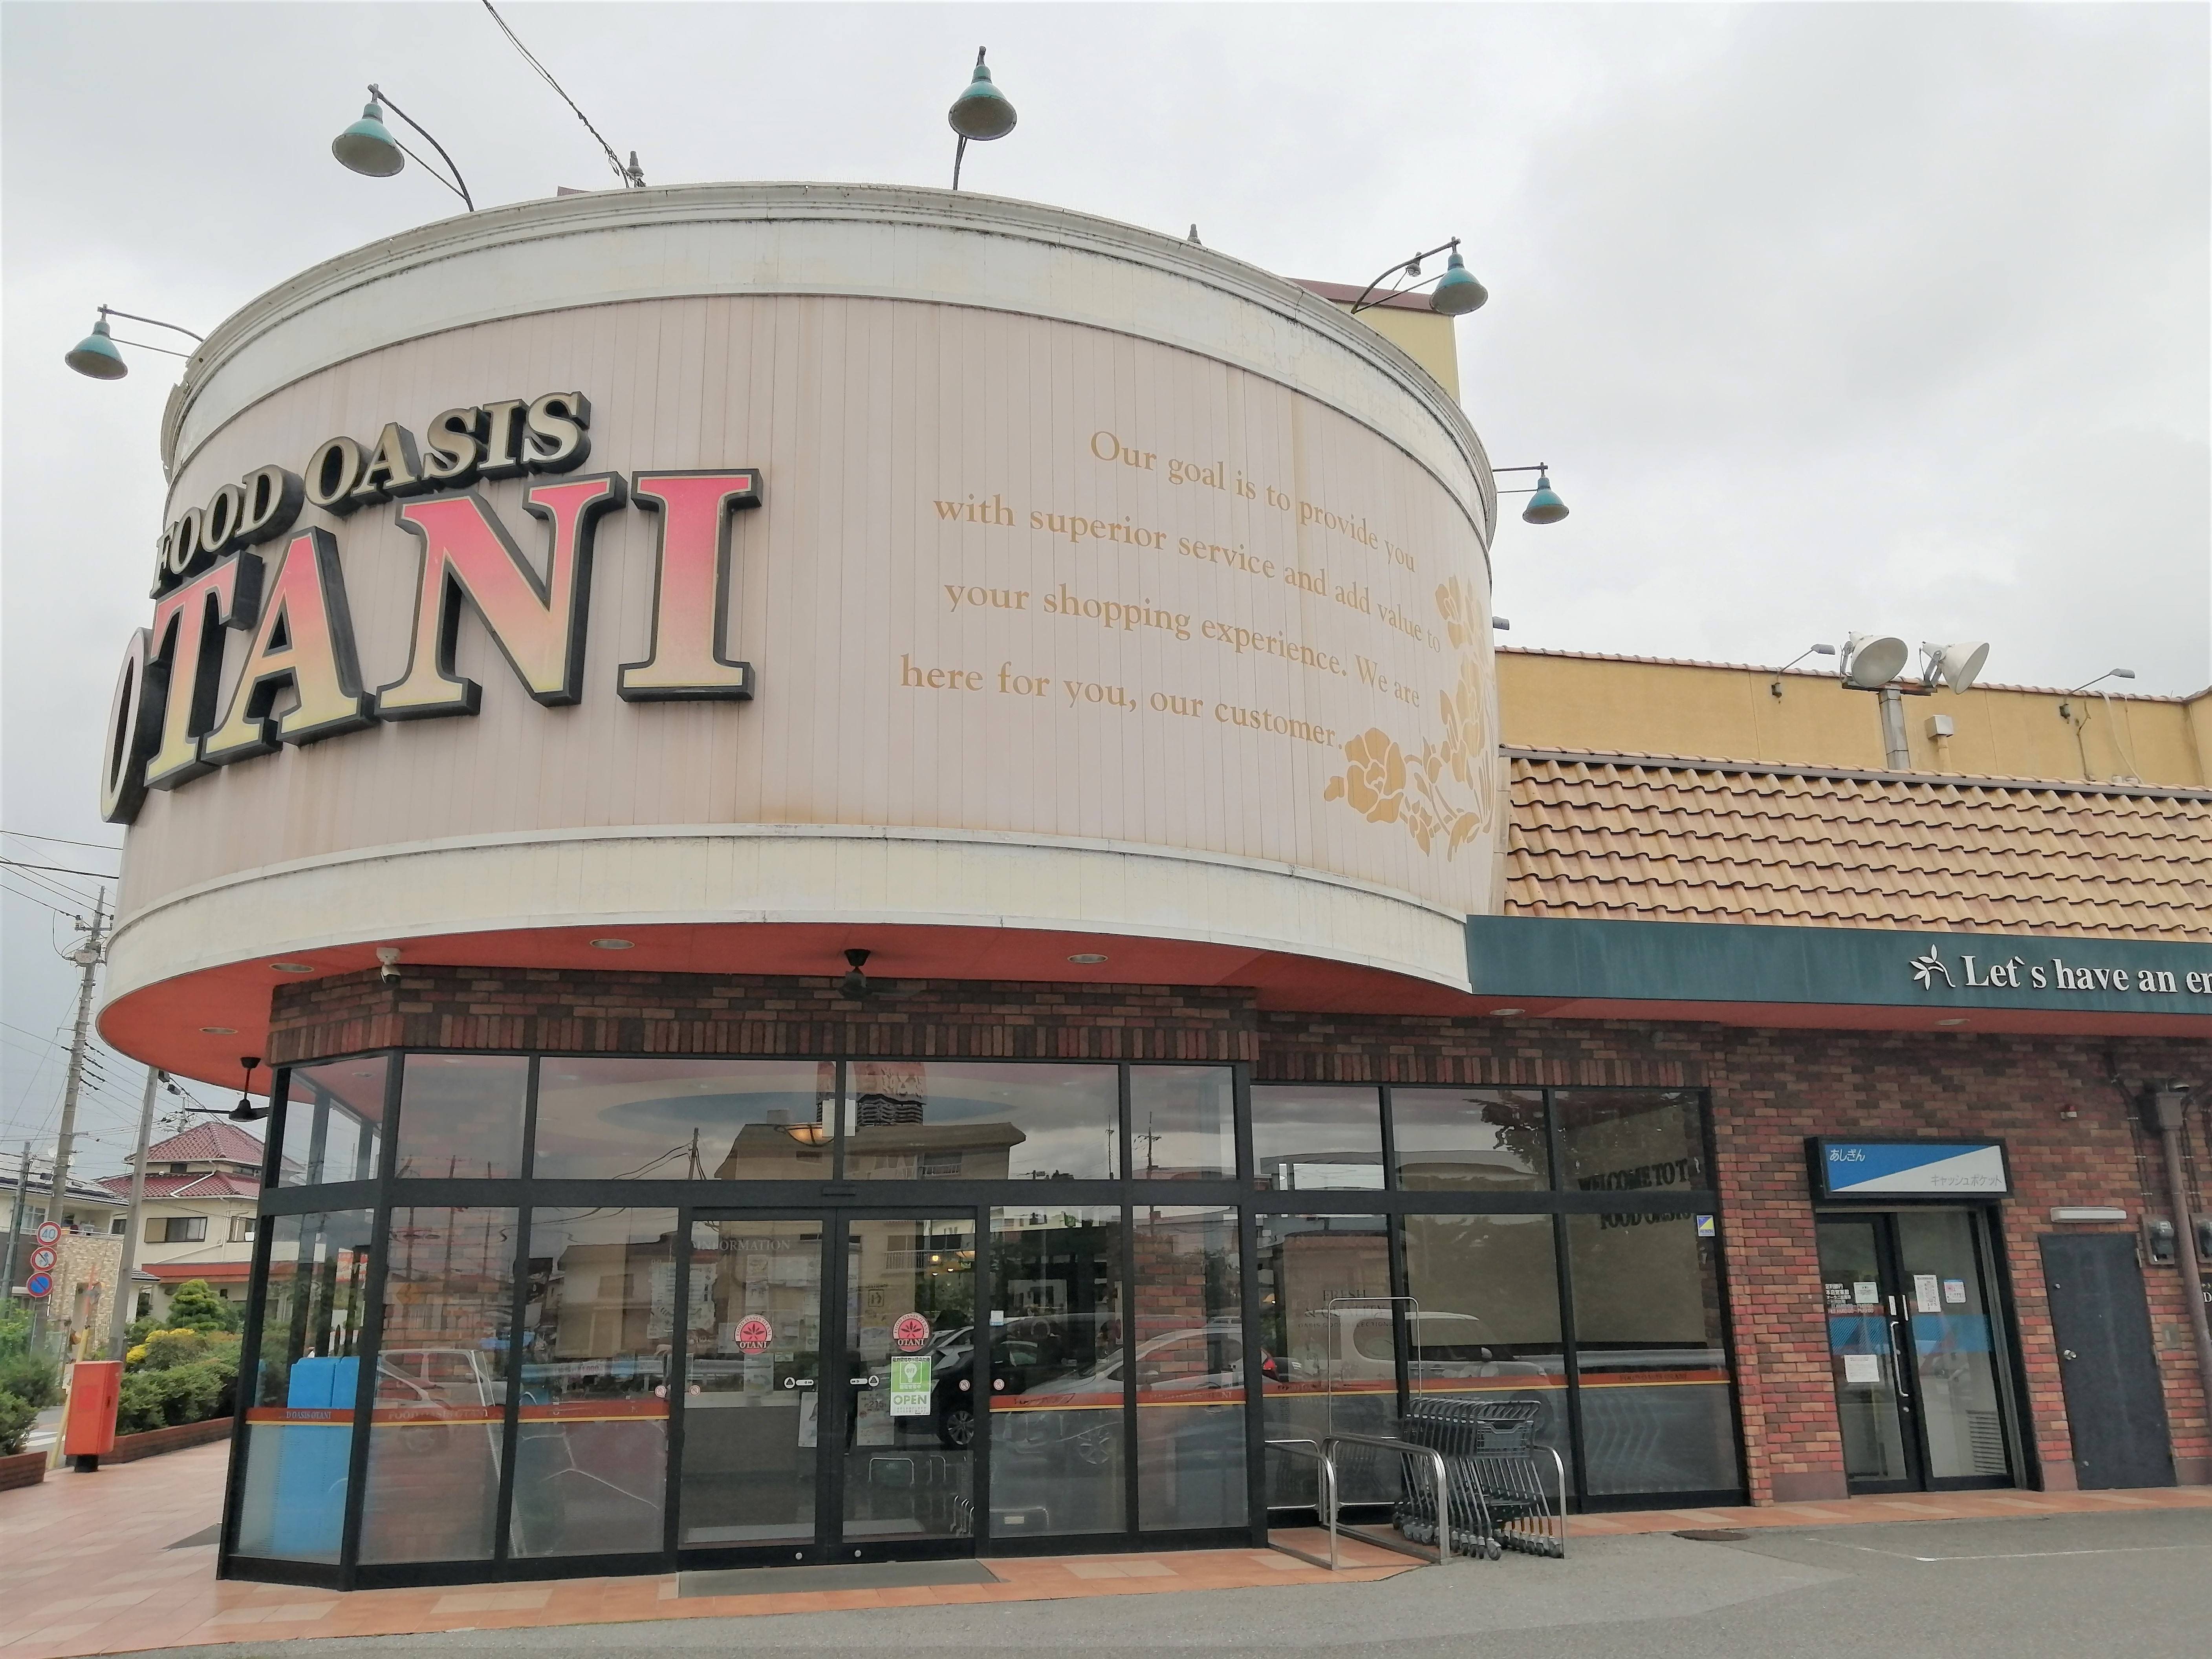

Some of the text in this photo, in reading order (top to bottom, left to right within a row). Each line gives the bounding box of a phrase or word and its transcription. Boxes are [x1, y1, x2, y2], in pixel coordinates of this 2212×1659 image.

[150, 391, 591, 599] FOOD OASIS
[1091, 431, 1415, 573] Our goal is to provide you
[933, 493, 1441, 654] with superior service and add value to
[101, 469, 762, 824] OTANI
[944, 583, 1420, 708] your shopping experience. We are
[901, 653, 1342, 750] here for you, our customer.
[2052, 958, 2130, 991] have
[2138, 969, 2178, 993] an
[1830, 1149, 1865, 1162] あしぎん
[1931, 1174, 2002, 1187] キャッシュポケット
[42, 1229, 55, 1239] 40
[697, 1240, 791, 1251] INFORMATION
[1324, 1289, 1366, 1301] FRESH
[893, 1395, 927, 1405] OPEN
